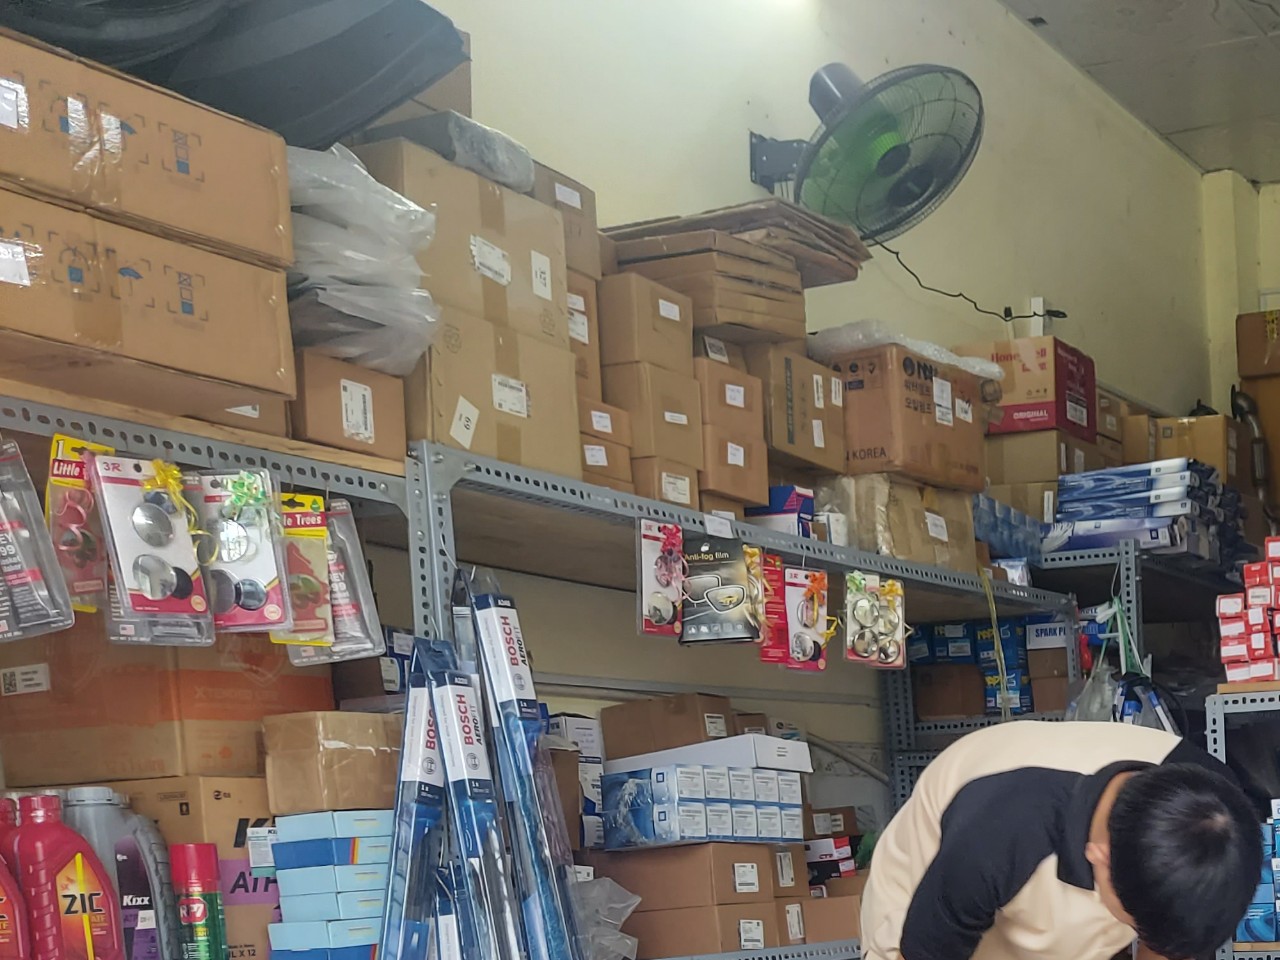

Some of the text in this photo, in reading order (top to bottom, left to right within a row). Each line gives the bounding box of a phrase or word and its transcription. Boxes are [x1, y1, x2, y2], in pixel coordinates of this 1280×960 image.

[1013, 410, 1049, 420] ORIGINAL
[852, 447, 888, 461] KOREA
[53, 461, 82, 477] Little
[103, 461, 123, 472] 3R
[296, 514, 322, 526] Trees
[684, 551, 730, 562] Anti-fog film
[1035, 626, 1058, 638] SPARK
[500, 616, 520, 667] BOSCH
[455, 694, 475, 746] BOSCH
[61, 892, 104, 915] ZIC
[122, 895, 151, 907] Kixx
[247, 948, 257, 957] 12
